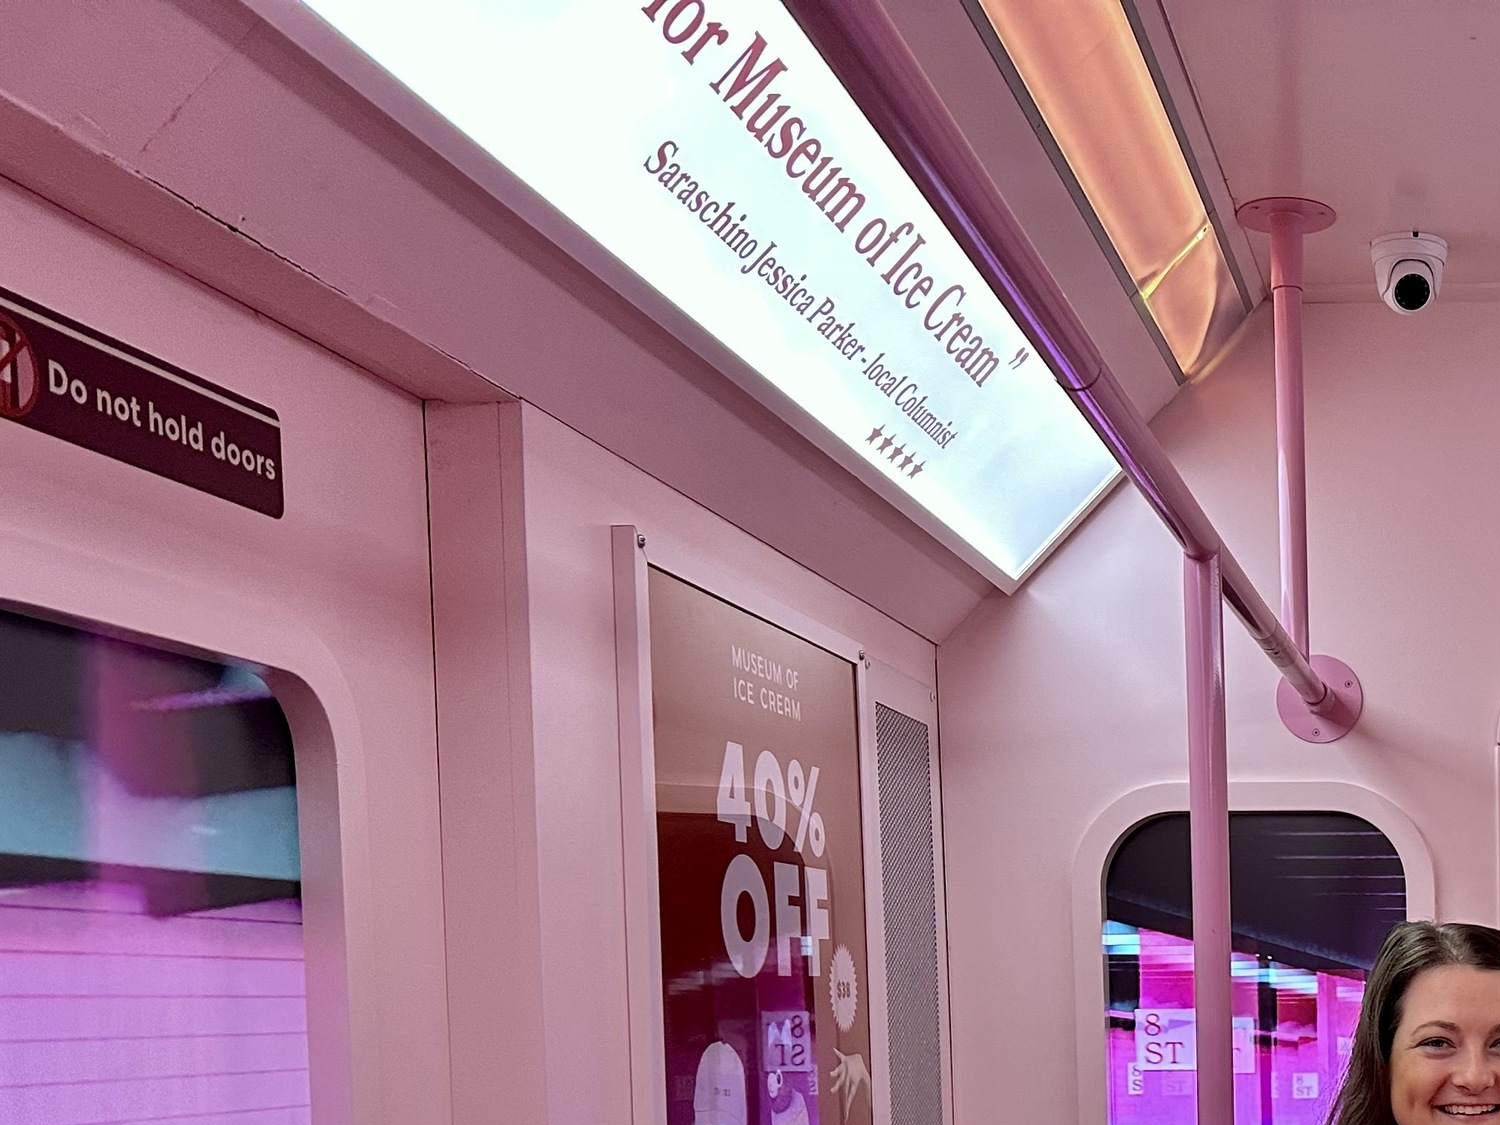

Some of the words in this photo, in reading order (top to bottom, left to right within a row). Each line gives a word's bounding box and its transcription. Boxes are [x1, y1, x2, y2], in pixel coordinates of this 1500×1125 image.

[709, 30, 866, 234] Museum
[855, 217, 914, 267] of
[879, 233, 934, 309] Ice
[642, 140, 758, 259] Saraschino
[740, 240, 815, 316] Jessica
[806, 296, 866, 361] Parker
[862, 352, 909, 398] local
[894, 383, 959, 450] Columnist
[923, 284, 1000, 388] Cream
[48, 359, 88, 405] Do
[96, 387, 142, 427] not
[148, 400, 204, 452] hold
[211, 431, 276, 480] doors
[731, 644, 783, 685] MUSEUM
[785, 668, 799, 692] OF
[733, 676, 755, 705] ICE
[760, 687, 802, 722] CREAM
[717, 740, 826, 858] 40%
[720, 853, 830, 979] OFF
[1143, 1013, 1162, 1036] 8
[1144, 1041, 1185, 1064] ST
[1132, 1079, 1143, 1092] S
[1296, 1086, 1313, 1097] ST
